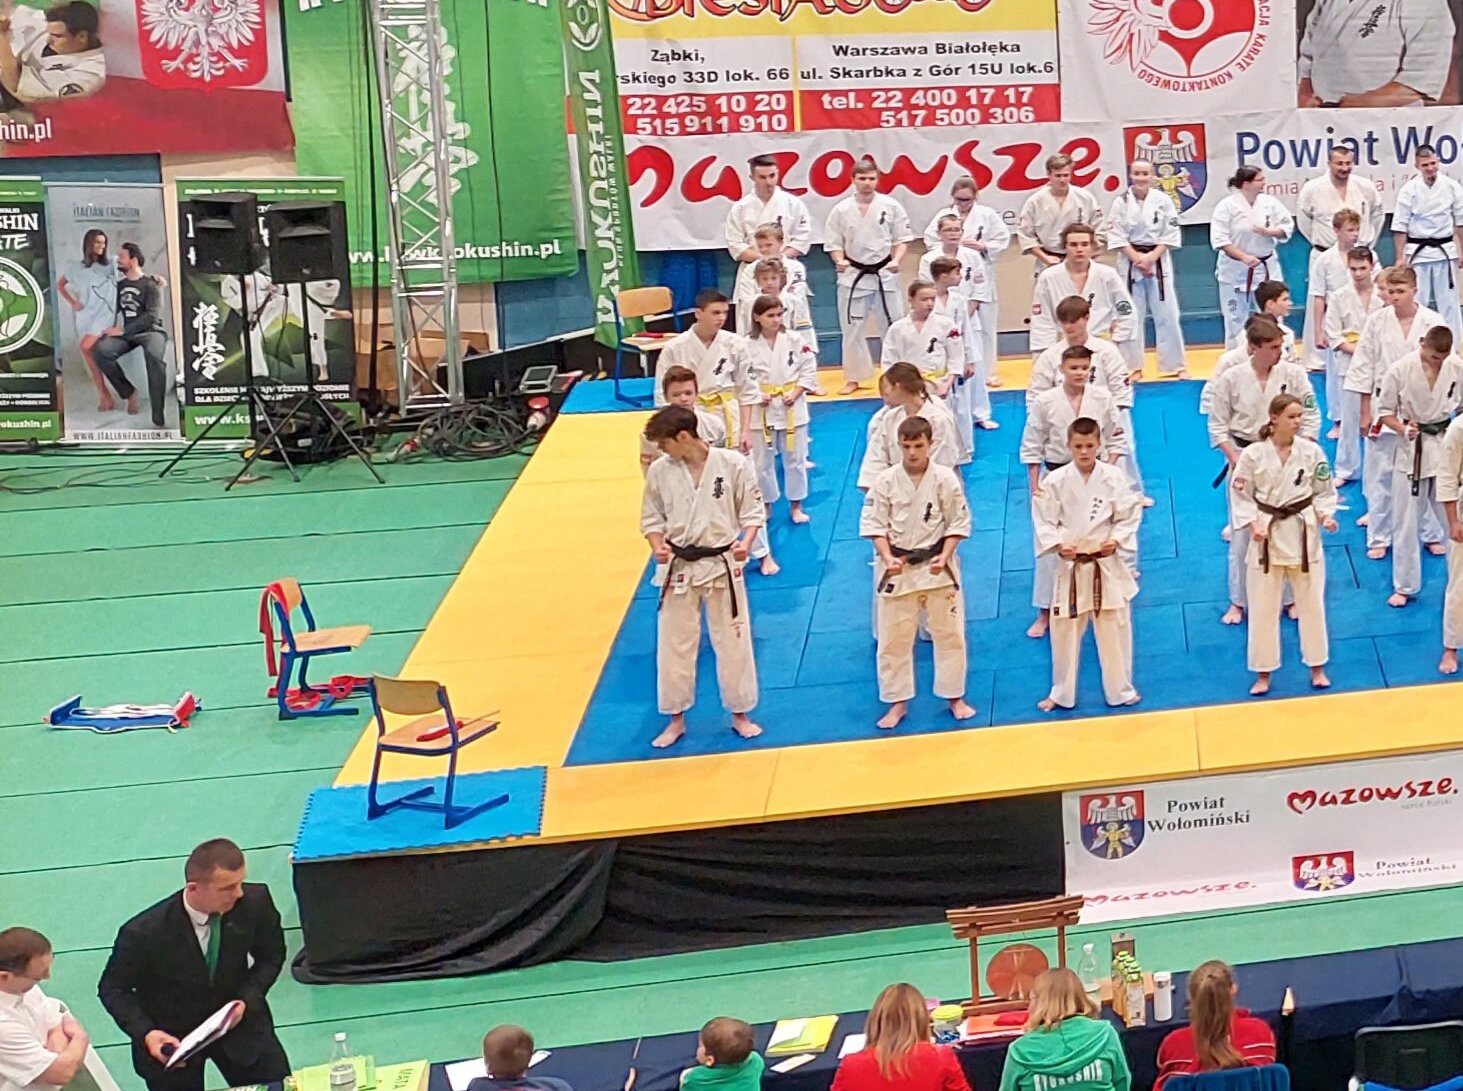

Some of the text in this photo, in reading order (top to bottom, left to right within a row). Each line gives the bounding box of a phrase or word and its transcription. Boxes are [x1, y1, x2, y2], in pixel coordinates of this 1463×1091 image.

[650, 48, 706, 66] Ząbki,
[831, 40, 1022, 58] Warszawa Białołęka
[1234, 31, 1268, 74] KARATE
[682, 70, 719, 84] 33D
[725, 68, 760, 82] lok.
[766, 67, 790, 81] 66
[799, 60, 1055, 81] ul. Skarbka z Gór 15U lok.6
[1135, 68, 1234, 93] KONTAKTOWEGO
[626, 92, 787, 116] 22 425 10 20
[821, 85, 1035, 110] tel. 22 400 17 17
[635, 113, 788, 136] 515 911 910
[879, 106, 1036, 128] 517 500 306
[1236, 129, 1379, 171] Powiat
[1167, 796, 1226, 814] Powiat
[1286, 776, 1459, 815] Mazowsze.
[1147, 809, 1251, 833] Wołomiński
